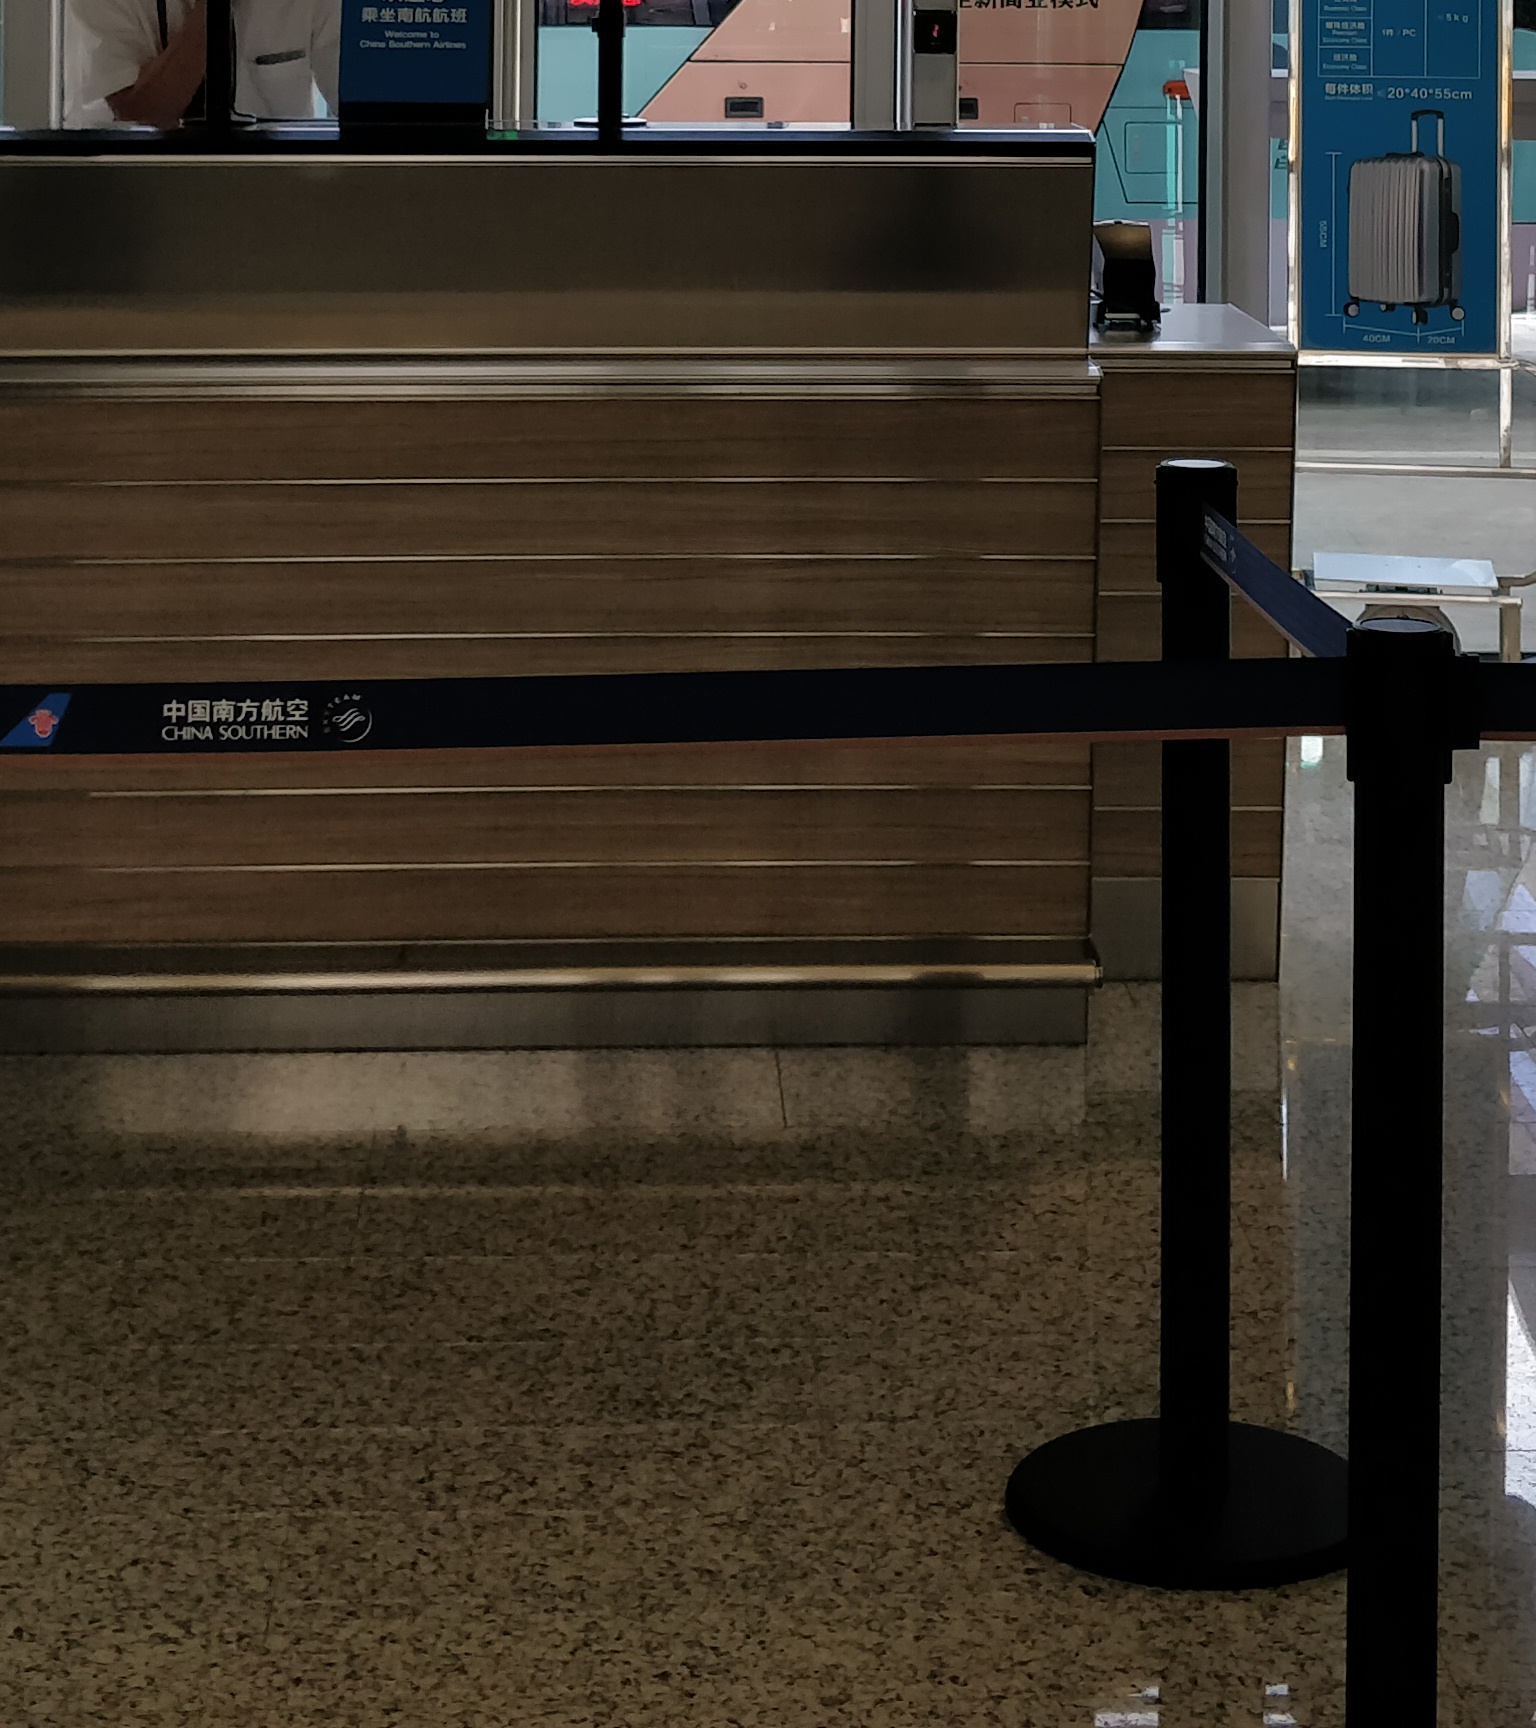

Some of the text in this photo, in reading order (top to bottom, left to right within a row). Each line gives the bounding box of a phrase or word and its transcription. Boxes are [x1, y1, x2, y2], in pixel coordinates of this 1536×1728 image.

[362, 7, 467, 23] 乘坐南航航班
[163, 698, 309, 723] 中国南方航空
[161, 725, 309, 741] CHINA SOUTHERN
